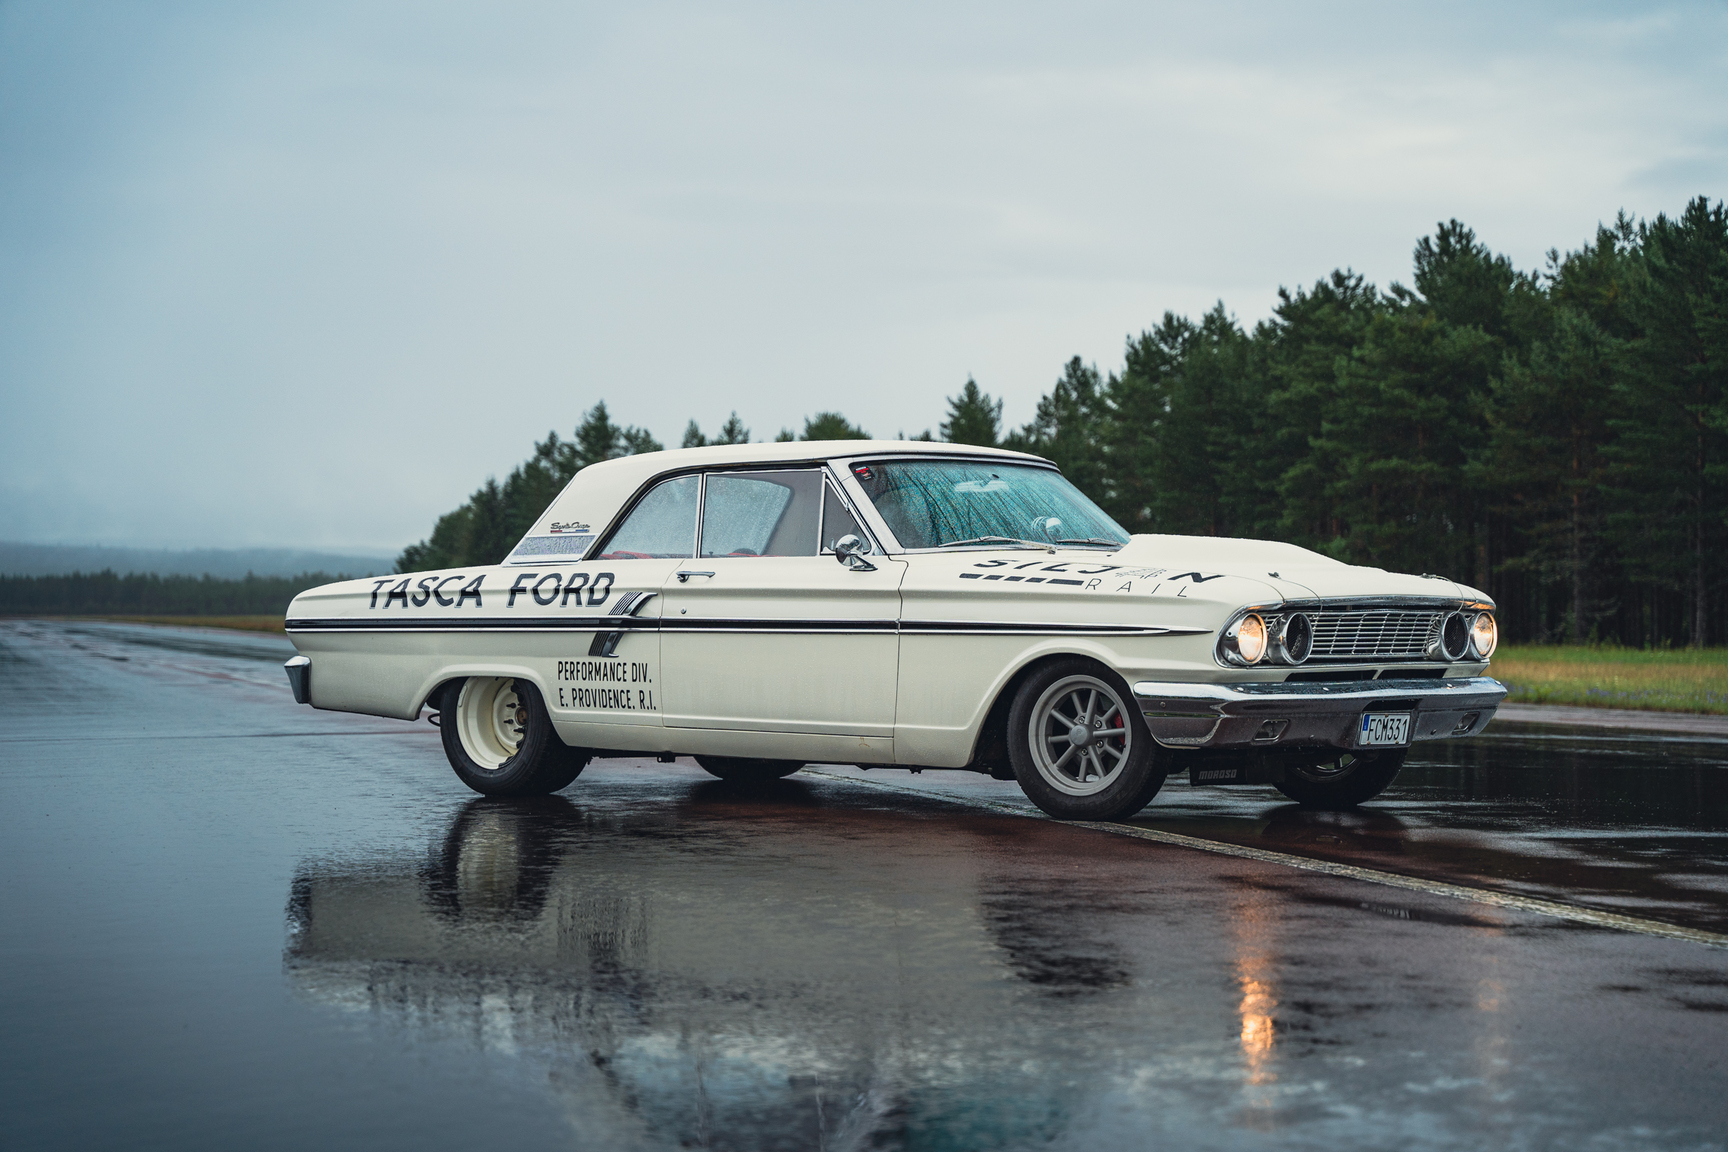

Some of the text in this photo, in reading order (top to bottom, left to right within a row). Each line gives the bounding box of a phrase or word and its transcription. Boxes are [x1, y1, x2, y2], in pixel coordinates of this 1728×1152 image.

[973, 559, 1226, 583] SILJN
[369, 572, 615, 609] TASCA FORD
[1085, 578, 1188, 598] RAIL
[557, 660, 652, 683] PERFORMANCE DIV.
[558, 687, 569, 707] E.
[639, 690, 657, 710] R.I.
[1367, 718, 1408, 741] FCM331
[1198, 769, 1237, 780] MOROSO
